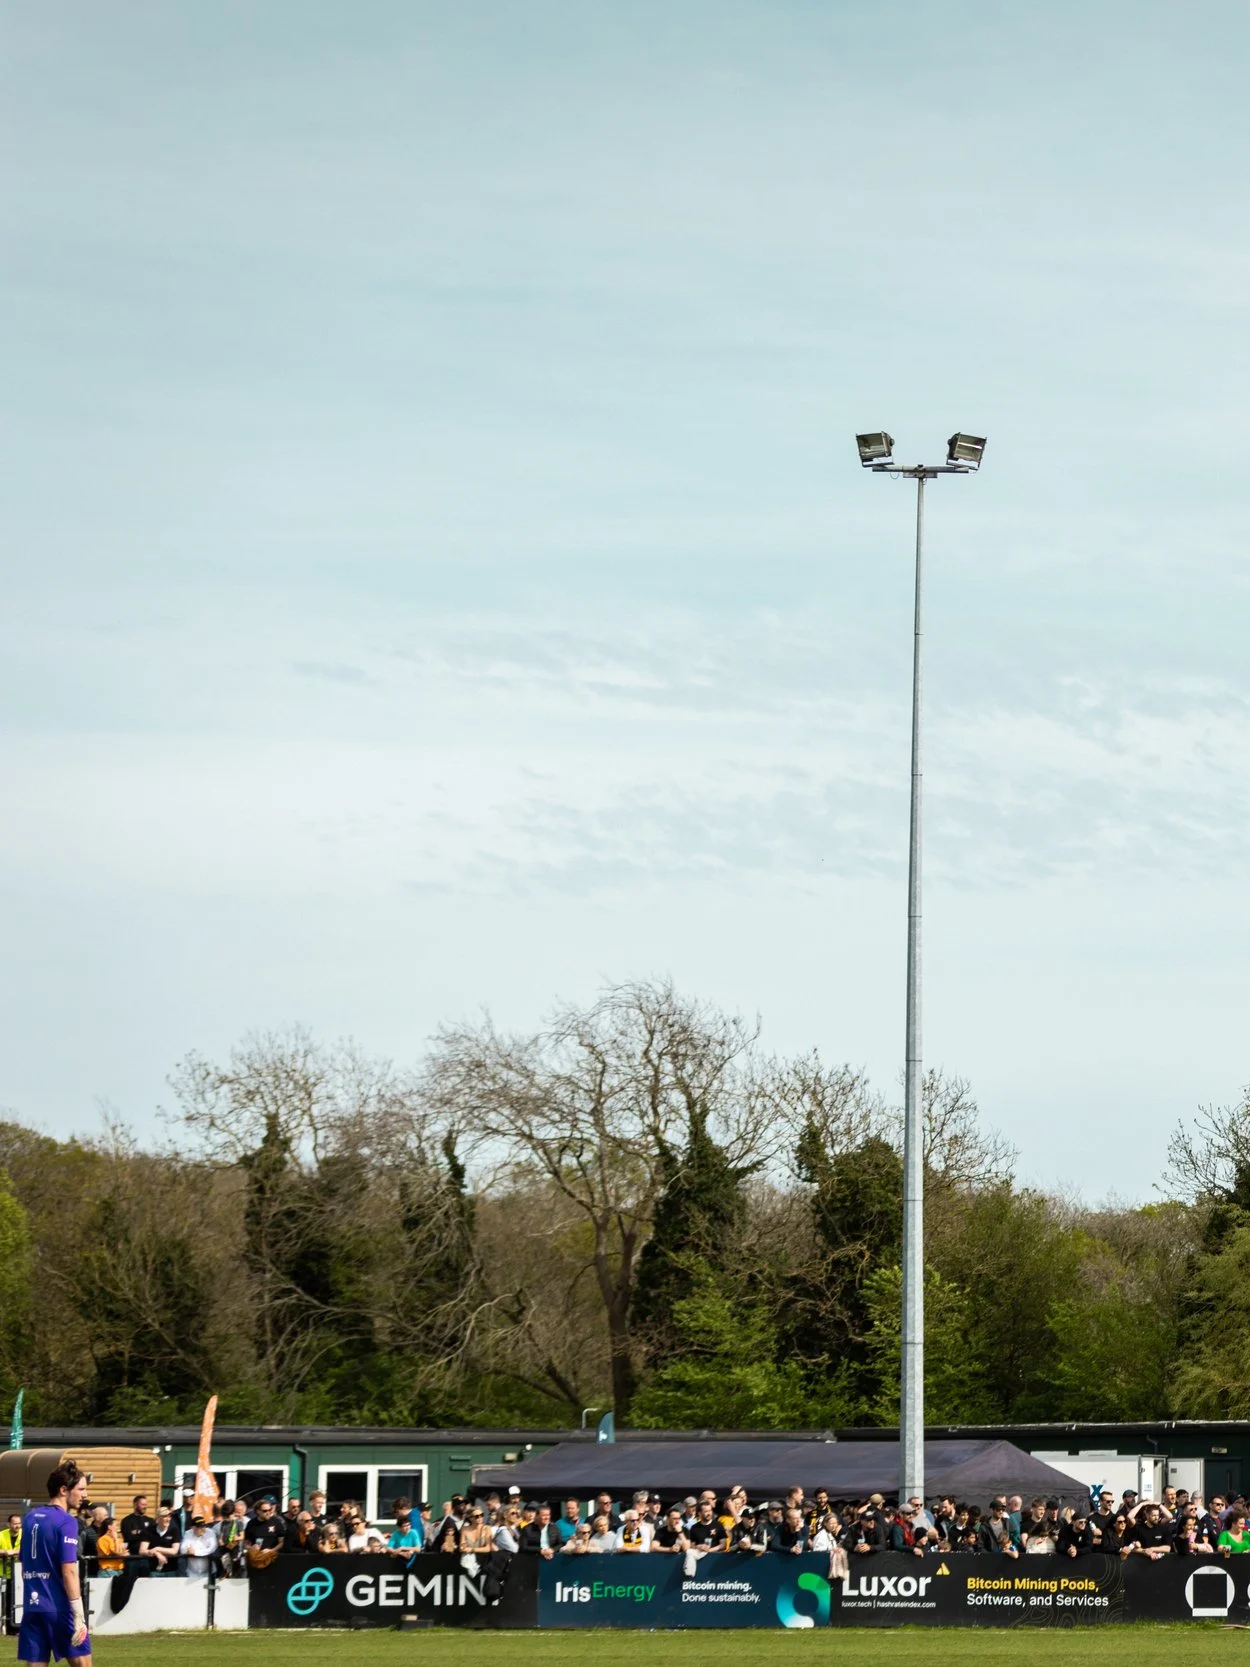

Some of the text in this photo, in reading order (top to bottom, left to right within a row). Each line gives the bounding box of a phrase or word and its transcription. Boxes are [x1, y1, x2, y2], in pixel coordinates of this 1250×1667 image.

[345, 1573, 500, 1607] GEMIN
[682, 1580, 753, 1592] Bitcoin mining.
[842, 1570, 932, 1597] Luxor
[967, 1577, 1100, 1592] Bitcoin Mining Pools,
[682, 1592, 761, 1604] Done sustainably.
[841, 1600, 872, 1608] luxor.tech
[966, 1593, 1109, 1608] Software, and Services
